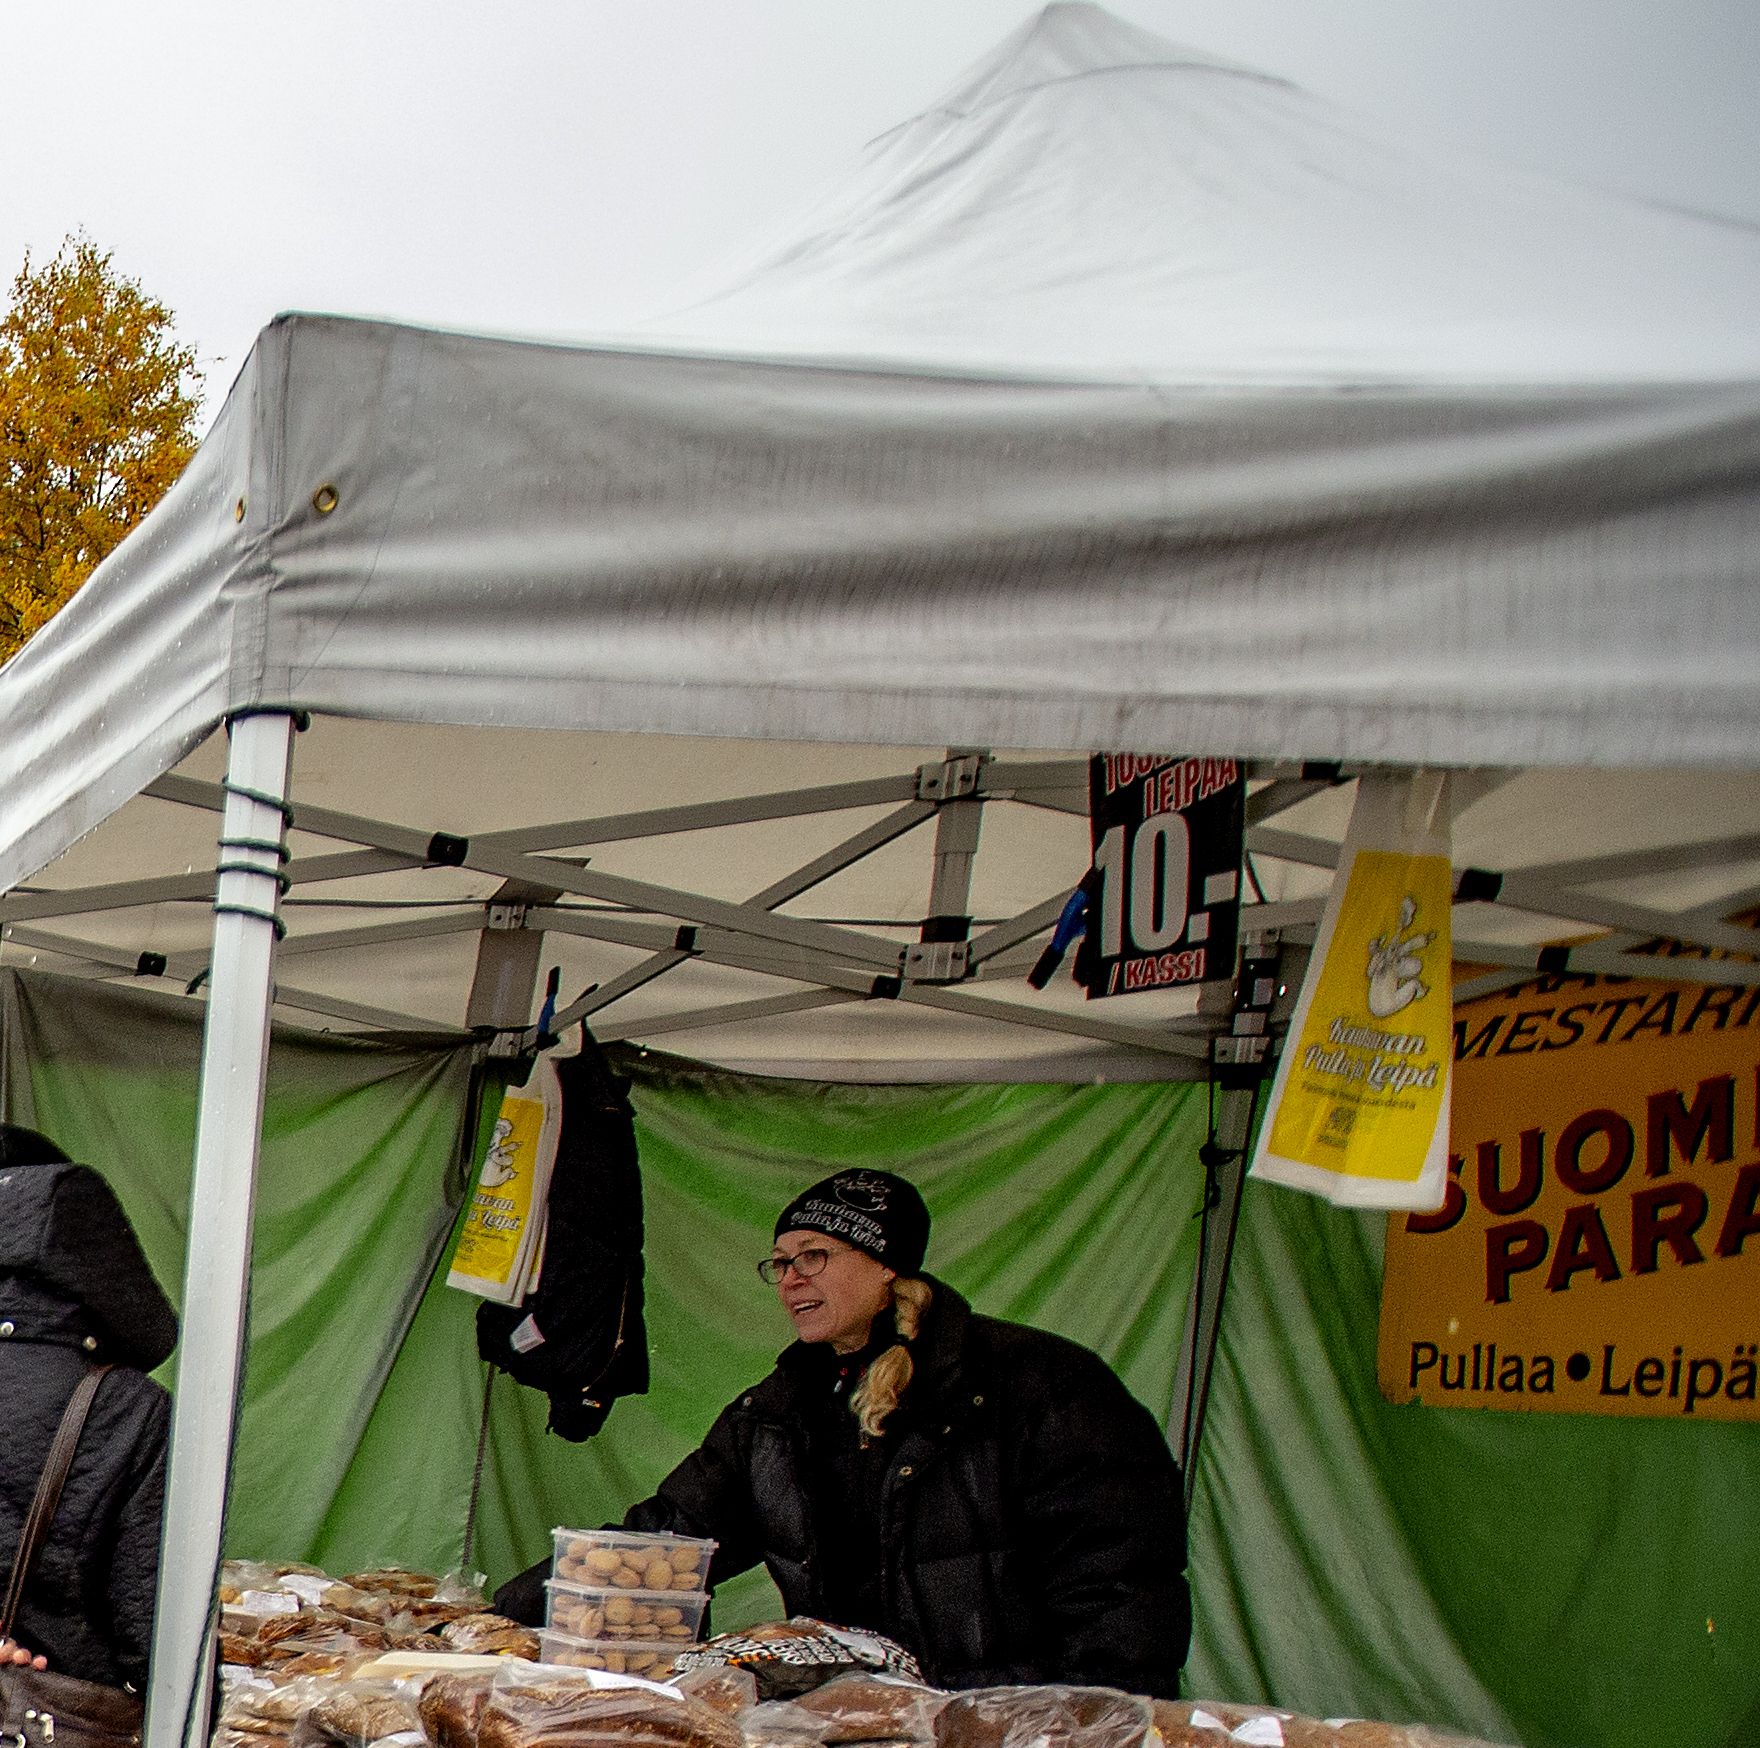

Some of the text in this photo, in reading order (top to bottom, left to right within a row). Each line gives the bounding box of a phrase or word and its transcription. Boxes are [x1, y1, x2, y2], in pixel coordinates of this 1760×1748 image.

[1095, 811, 1237, 958] 10.-
[1124, 948, 1205, 988] KASSI
[1409, 1341, 1556, 1393] Pullaa
